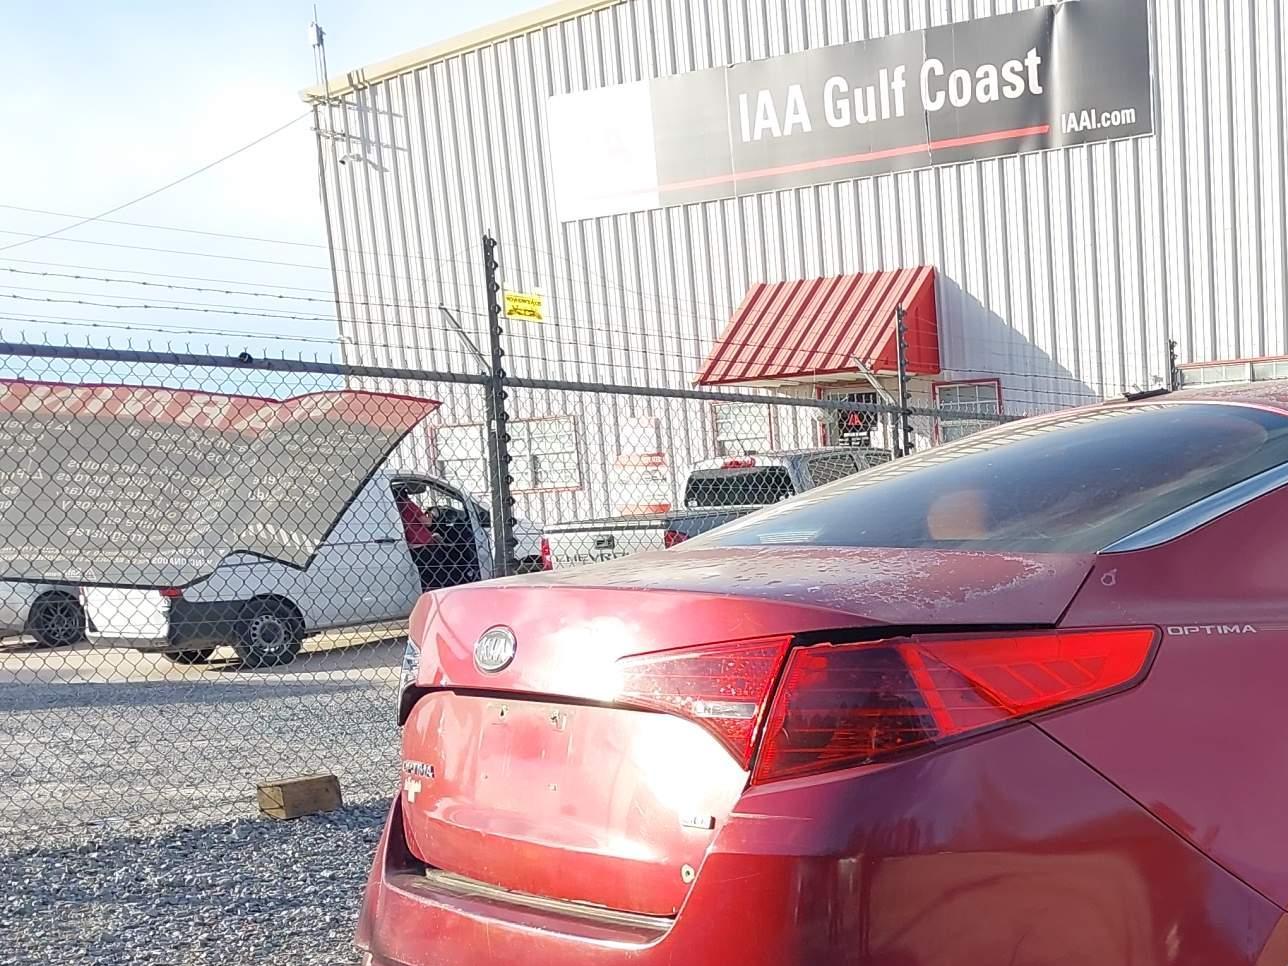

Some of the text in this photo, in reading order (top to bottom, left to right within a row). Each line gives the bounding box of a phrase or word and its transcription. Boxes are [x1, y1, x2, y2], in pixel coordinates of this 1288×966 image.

[739, 47, 1043, 143] IAA Gulf Coast
[1061, 106, 1136, 134] IAAI.com
[1167, 624, 1257, 636] OPTIMA
